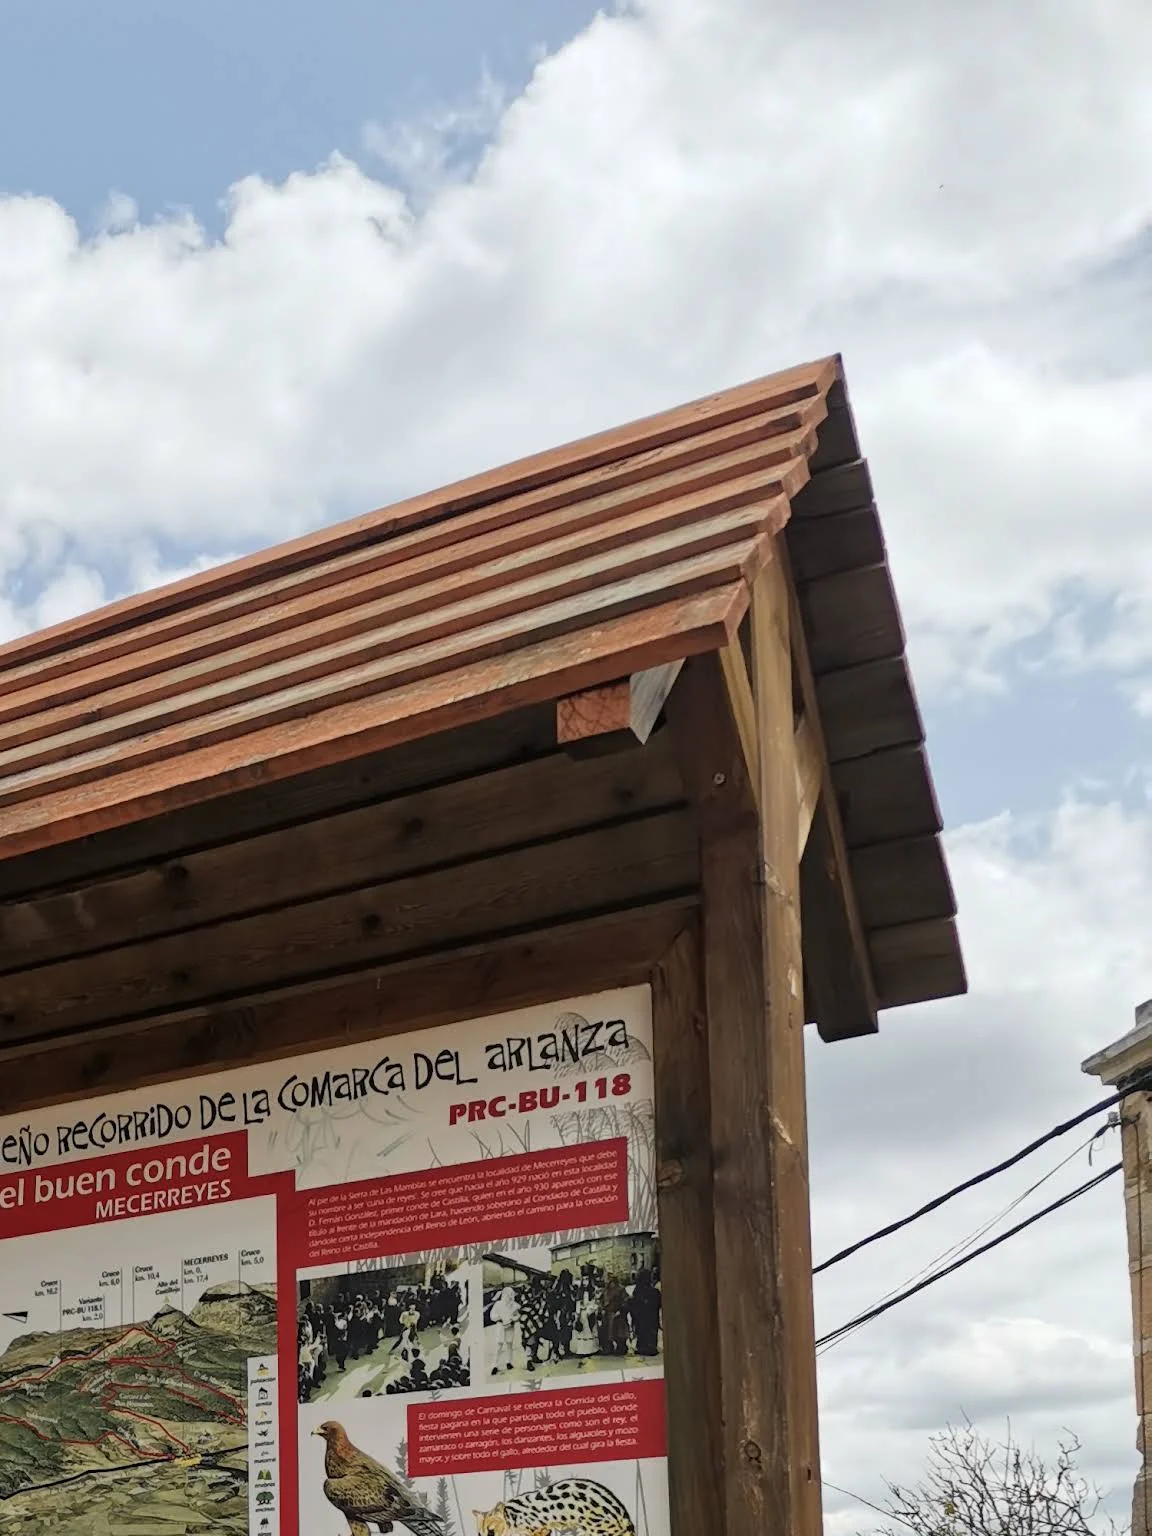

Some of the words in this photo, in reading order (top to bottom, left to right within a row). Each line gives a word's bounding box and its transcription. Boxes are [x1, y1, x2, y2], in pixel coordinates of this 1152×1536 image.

[449, 1073, 632, 1127] PRC-BU-118
[34, 1166, 115, 1203] buen
[126, 1143, 232, 1187] conde
[308, 1197, 315, 1205] Al
[316, 1195, 328, 1206] pie
[329, 1193, 338, 1202] de
[339, 1192, 347, 1200] la
[369, 1187, 378, 1196] de
[379, 1185, 392, 1194] Las
[476, 1170, 484, 1179] la
[520, 1162, 531, 1171] de
[578, 1154, 595, 1164] que
[430, 1198, 440, 1207] de
[507, 1186, 515, 1195] el
[516, 1184, 532, 1194] año
[533, 1181, 549, 1191] 930
[585, 1175, 602, 1183] con
[603, 1173, 618, 1181] ese
[95, 1178, 232, 1219] MECERREYES
[418, 1411, 426, 1419] El
[464, 1406, 475, 1415] de
[554, 1398, 562, 1407] la
[596, 1394, 610, 1403] del
[482, 1416, 490, 1424] la
[491, 1417, 507, 1425] que
[566, 1408, 575, 1417] el
